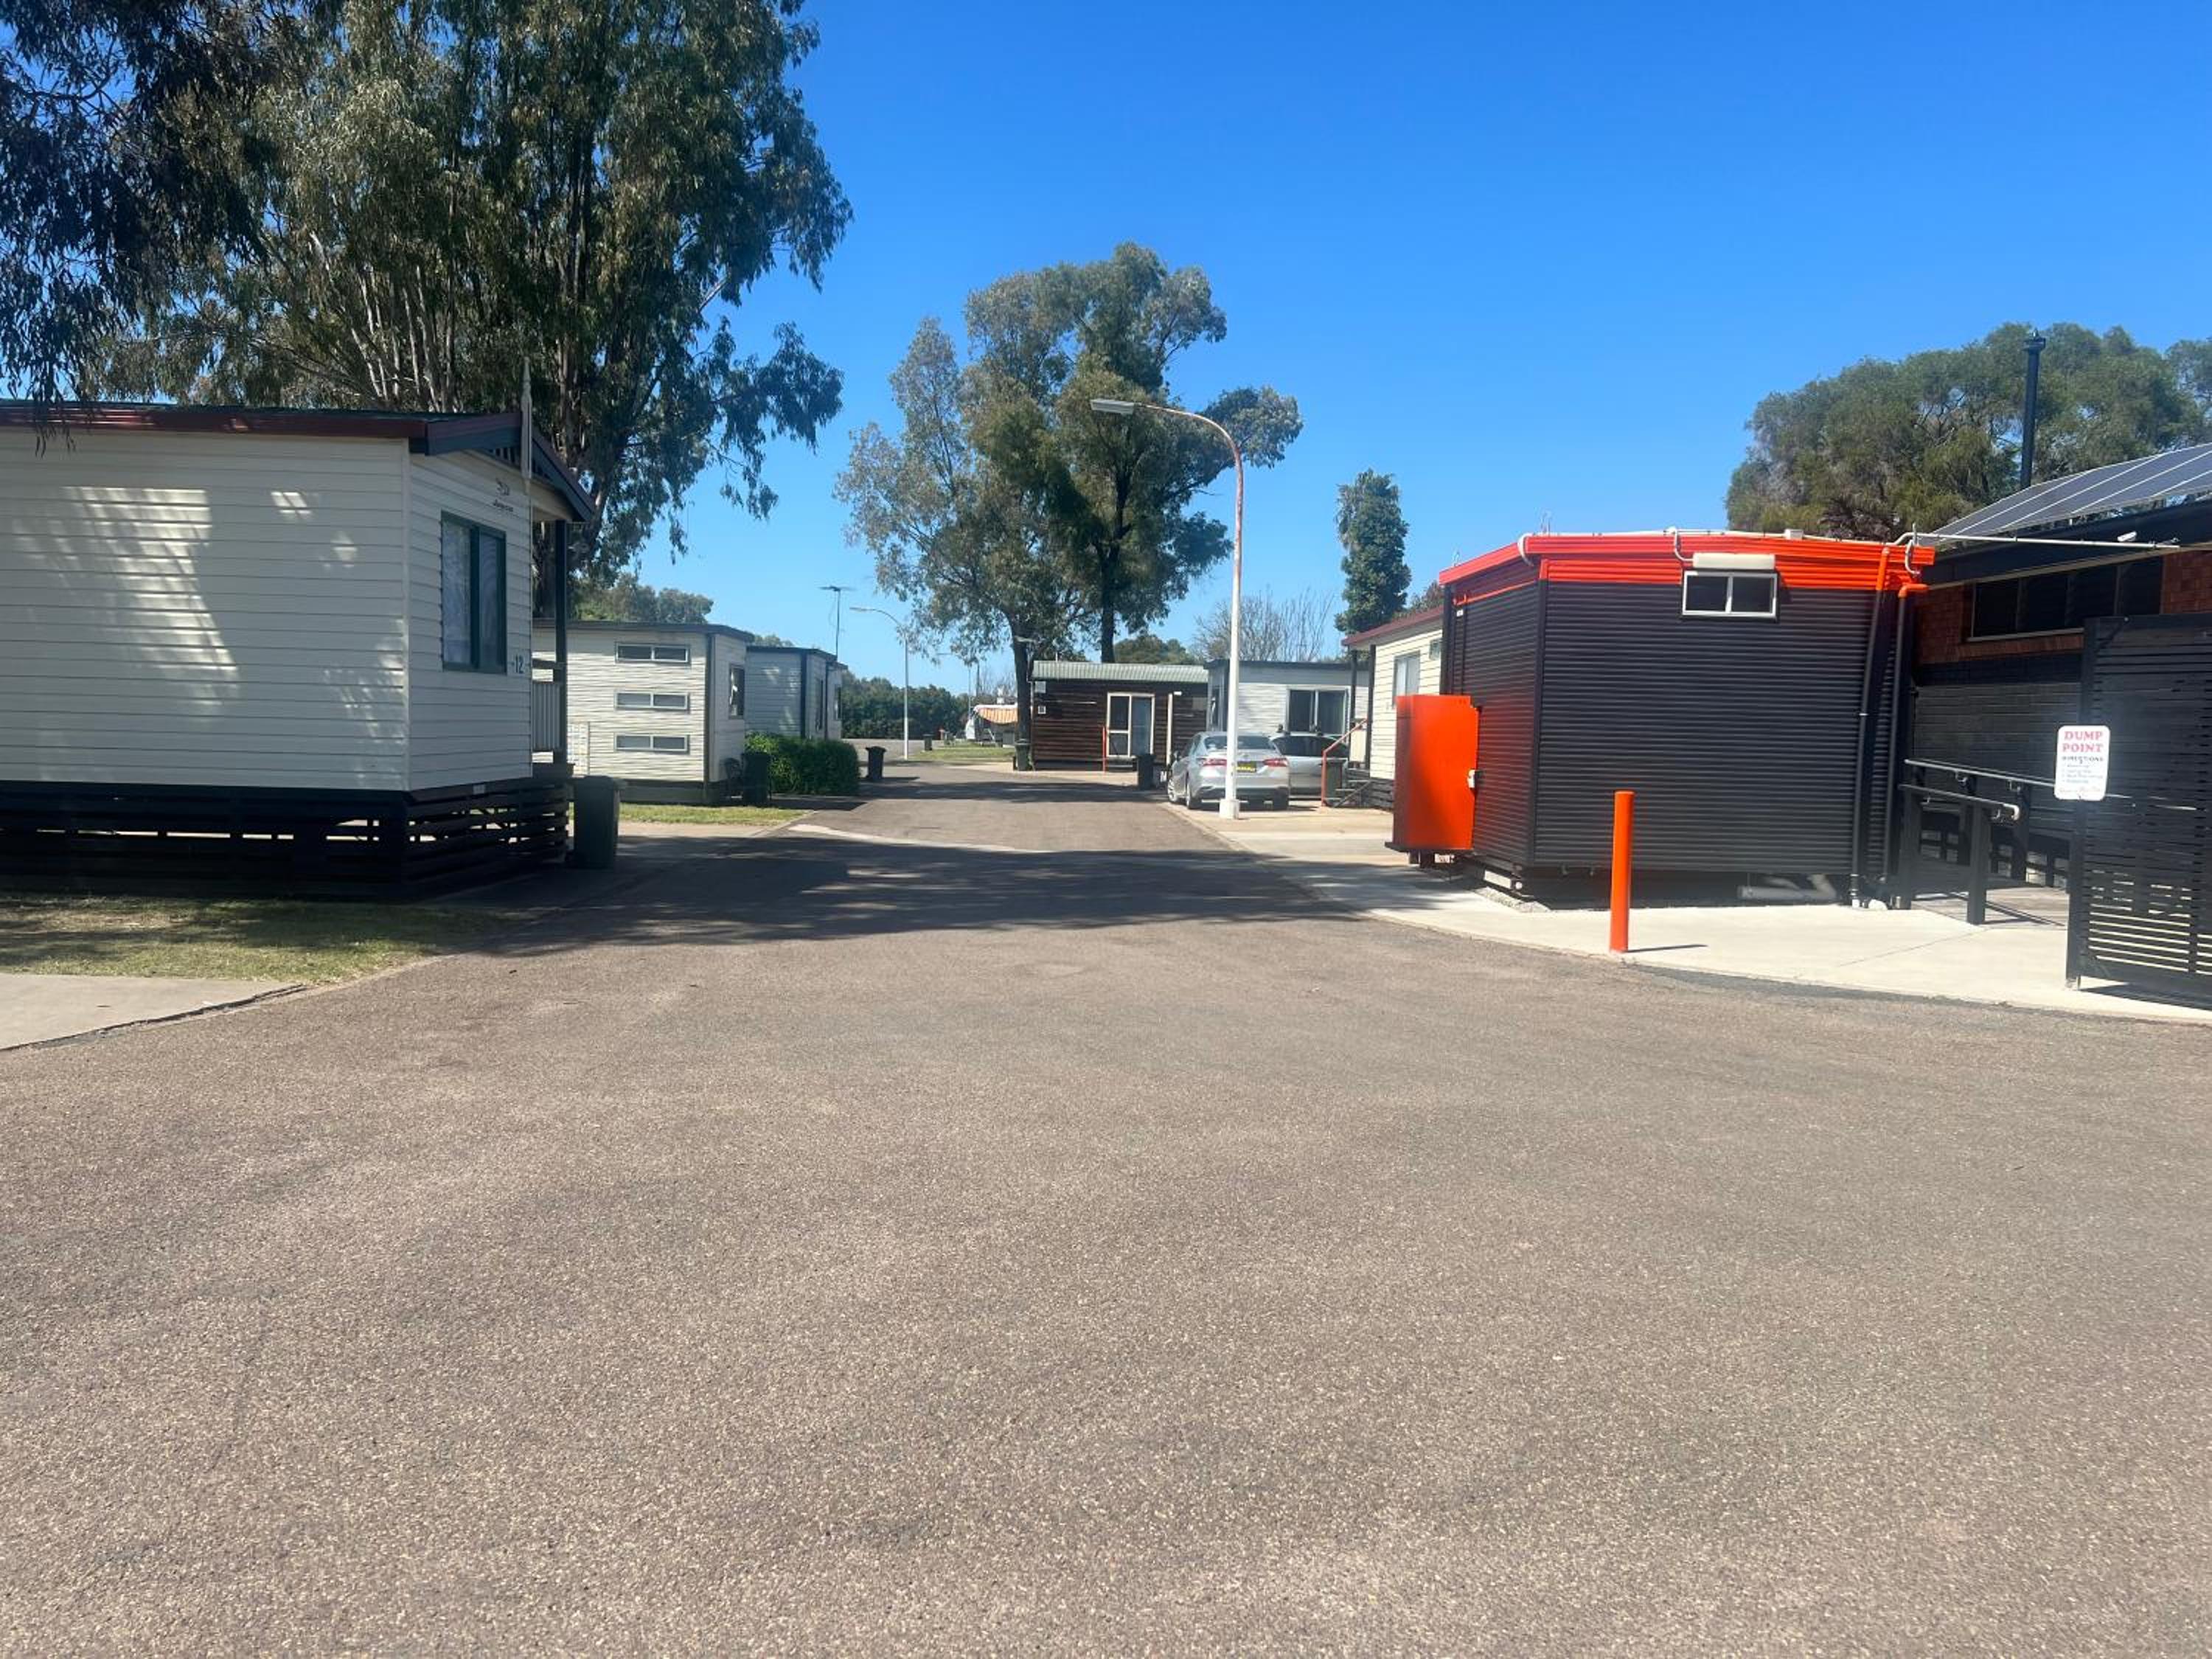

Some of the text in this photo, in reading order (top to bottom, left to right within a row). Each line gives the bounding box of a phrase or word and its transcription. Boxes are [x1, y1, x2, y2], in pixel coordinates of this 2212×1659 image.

[515, 654, 524, 675] 12
[2065, 731, 2103, 740] DUMP
[2062, 743, 2104, 753] POINT
